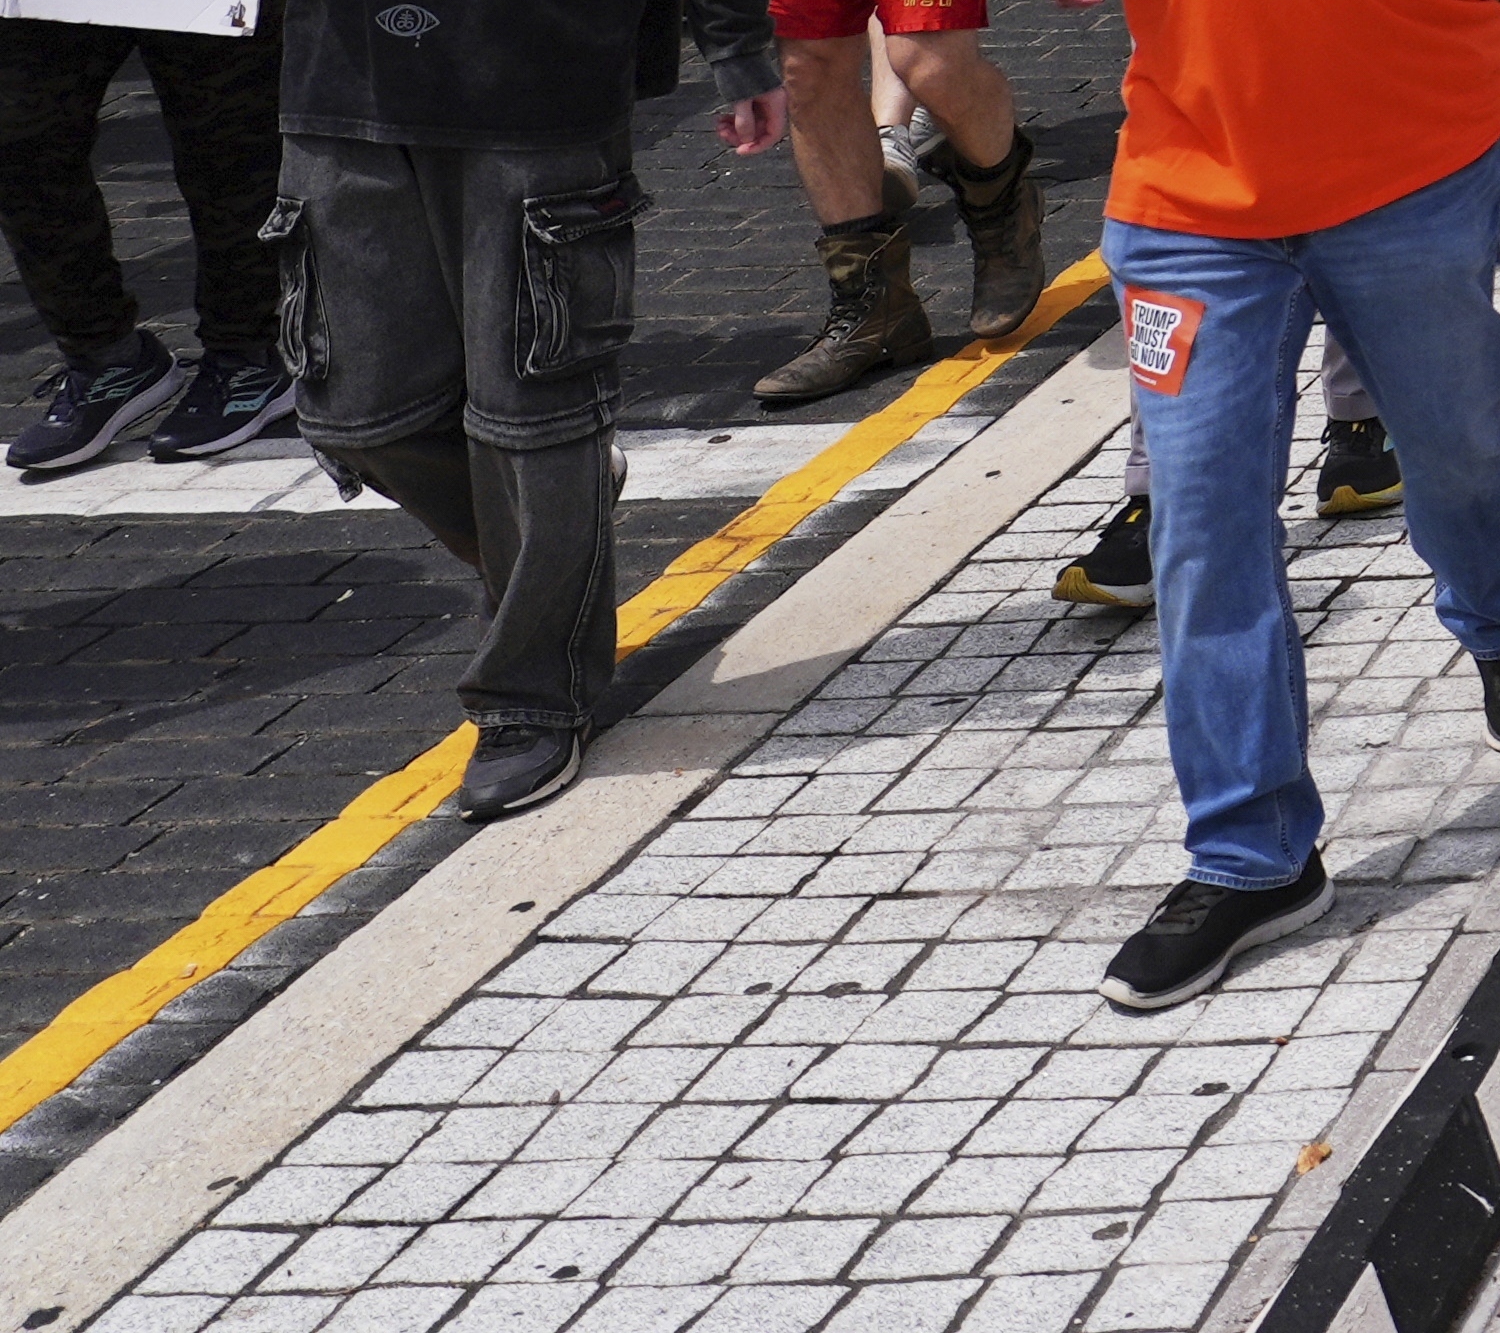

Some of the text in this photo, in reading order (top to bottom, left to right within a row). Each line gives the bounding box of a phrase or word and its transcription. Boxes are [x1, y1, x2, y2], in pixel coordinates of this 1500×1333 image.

[1134, 304, 1178, 330] TRUMP
[1135, 324, 1167, 349] MUST
[1141, 347, 1171, 371] NOW
